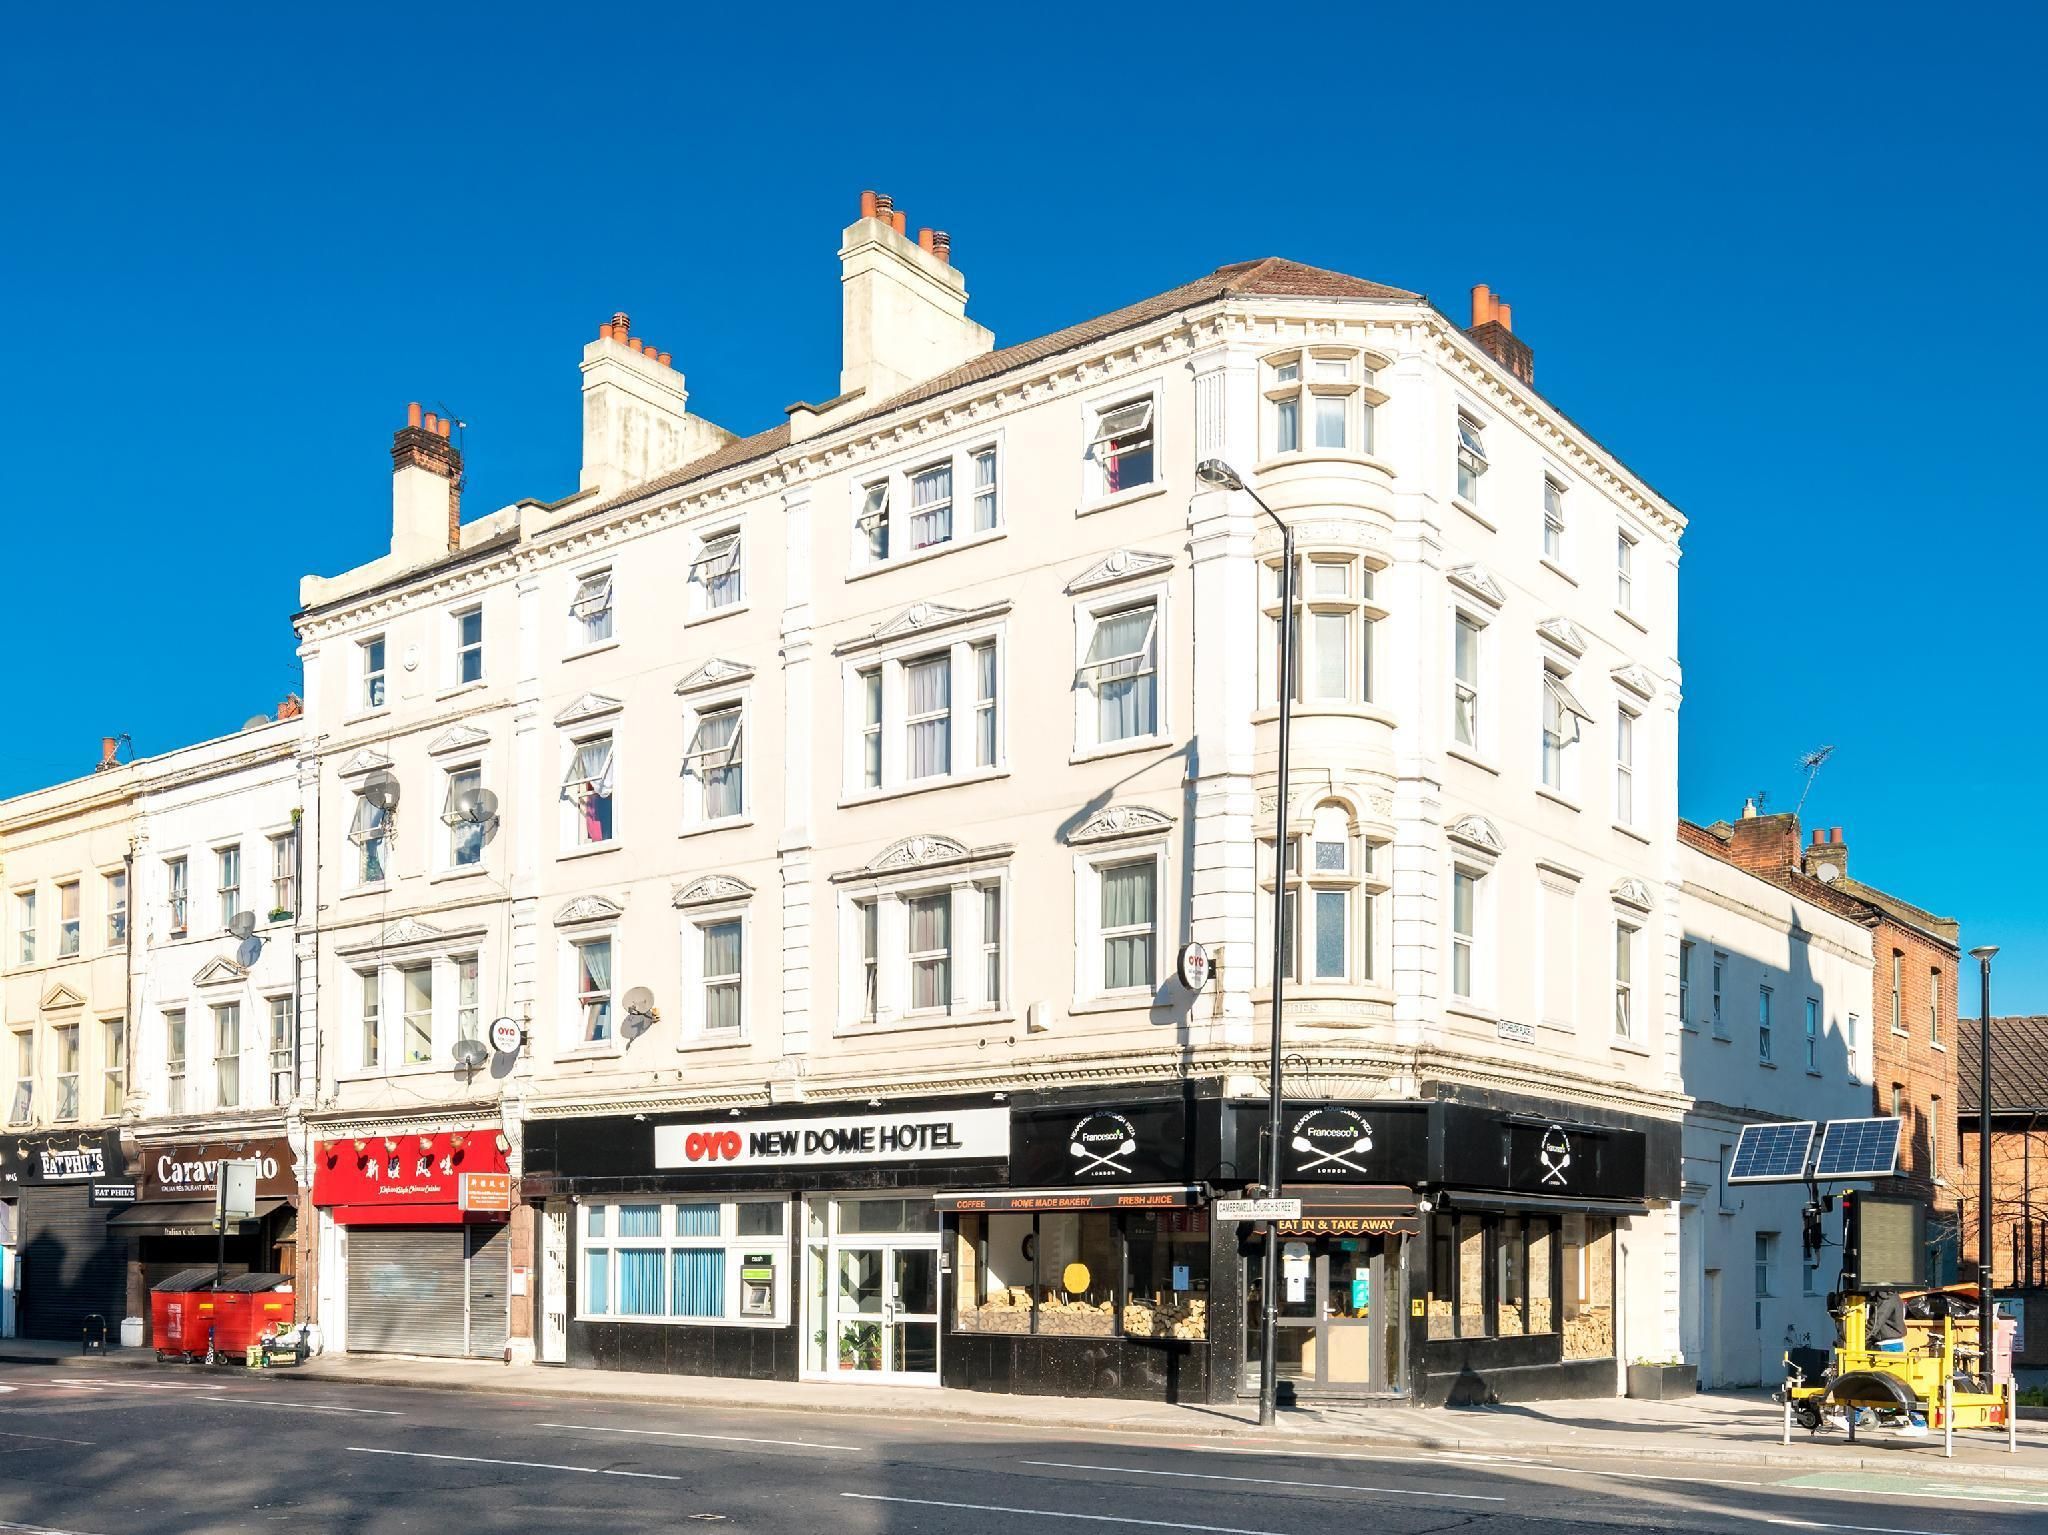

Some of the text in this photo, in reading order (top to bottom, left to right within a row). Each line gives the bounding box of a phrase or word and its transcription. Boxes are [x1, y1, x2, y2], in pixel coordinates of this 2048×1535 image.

[1188, 955, 1204, 968] OYO
[497, 1026, 515, 1036] OYO
[1082, 1128, 1124, 1142] Francesco's
[1307, 1126, 1359, 1138] Francesco's
[685, 1122, 963, 1162] OYO NEW DOME HOTEL
[41, 1152, 105, 1174] FAT PHIL'S
[157, 1150, 278, 1183] Caravio
[94, 1188, 135, 1197] FAT PHIL'S
[957, 1200, 986, 1209] COFFEE
[1011, 1197, 1091, 1208] HOME MADE BAKERY
[1118, 1195, 1173, 1205] FRESH JUICE
[1218, 1202, 1252, 1213] CAMBERWELL
[1275, 1201, 1294, 1212] STREET
[1279, 1220, 1395, 1230] EAT IN & TAKE AWAY
